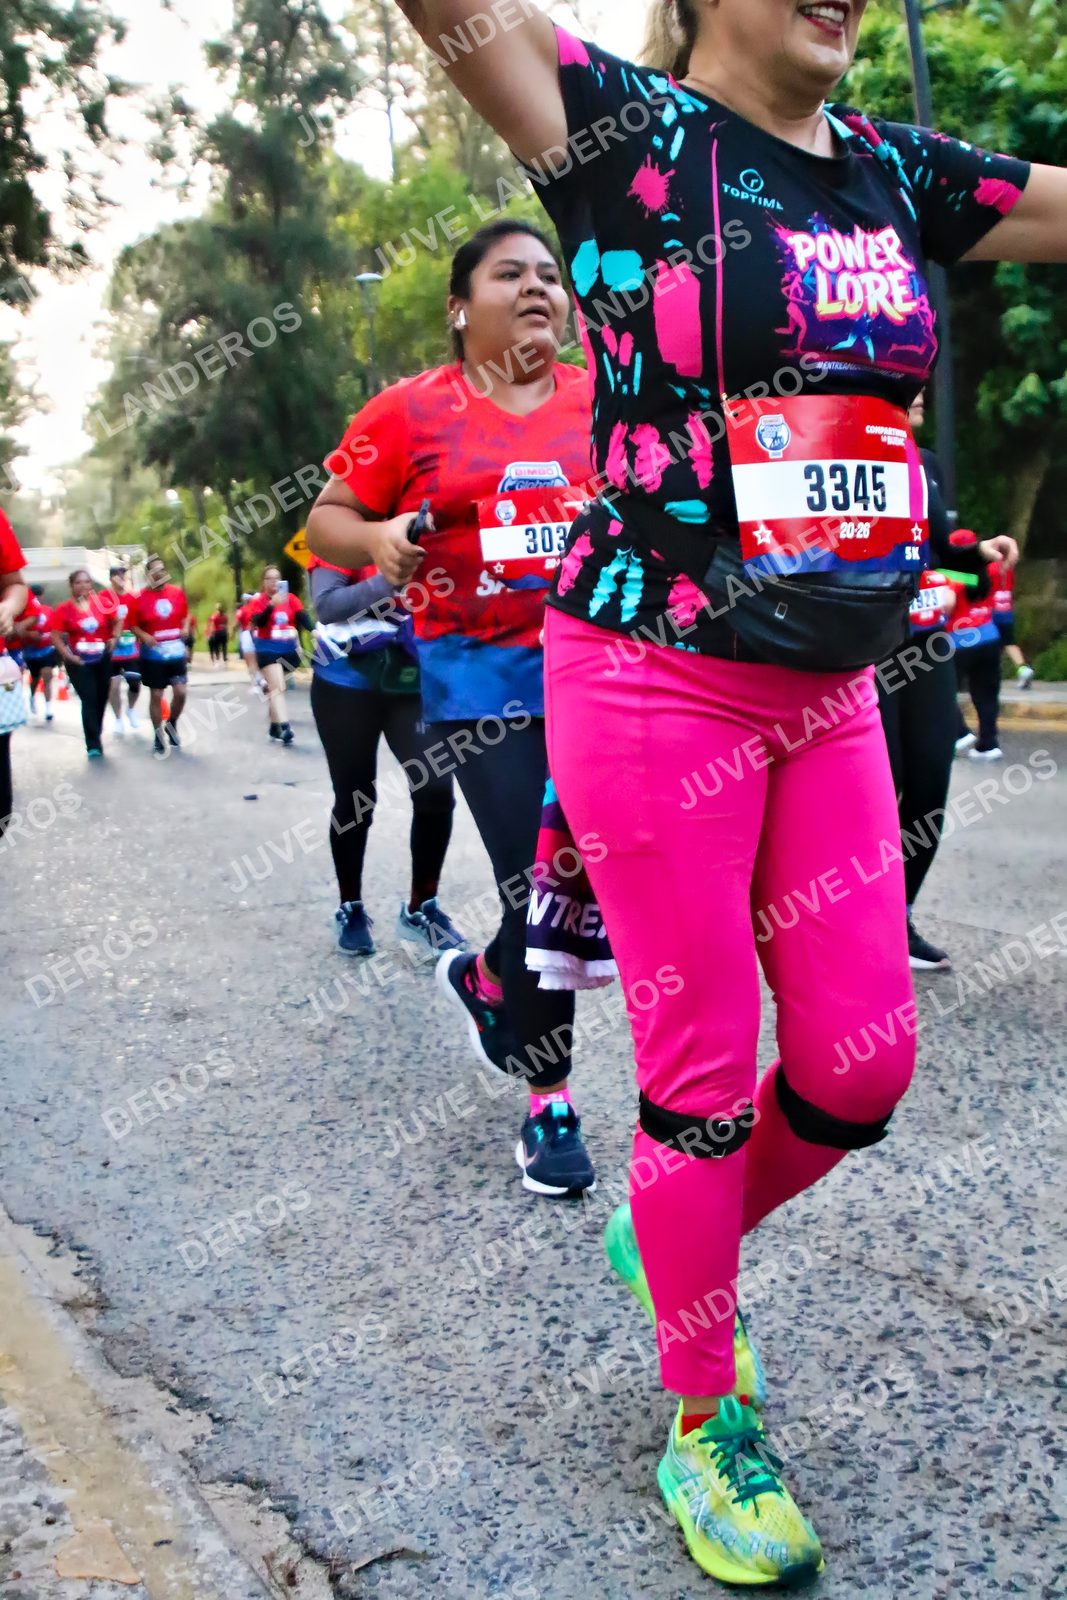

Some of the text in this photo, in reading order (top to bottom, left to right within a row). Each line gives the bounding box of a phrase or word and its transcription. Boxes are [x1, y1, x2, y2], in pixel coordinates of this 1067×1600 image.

[786, 226, 915, 272] POWER
[815, 267, 919, 322] LORE
[804, 463, 887, 512] 3345
[905, 546, 920, 560] 5K
[526, 888, 607, 939] NTRE
